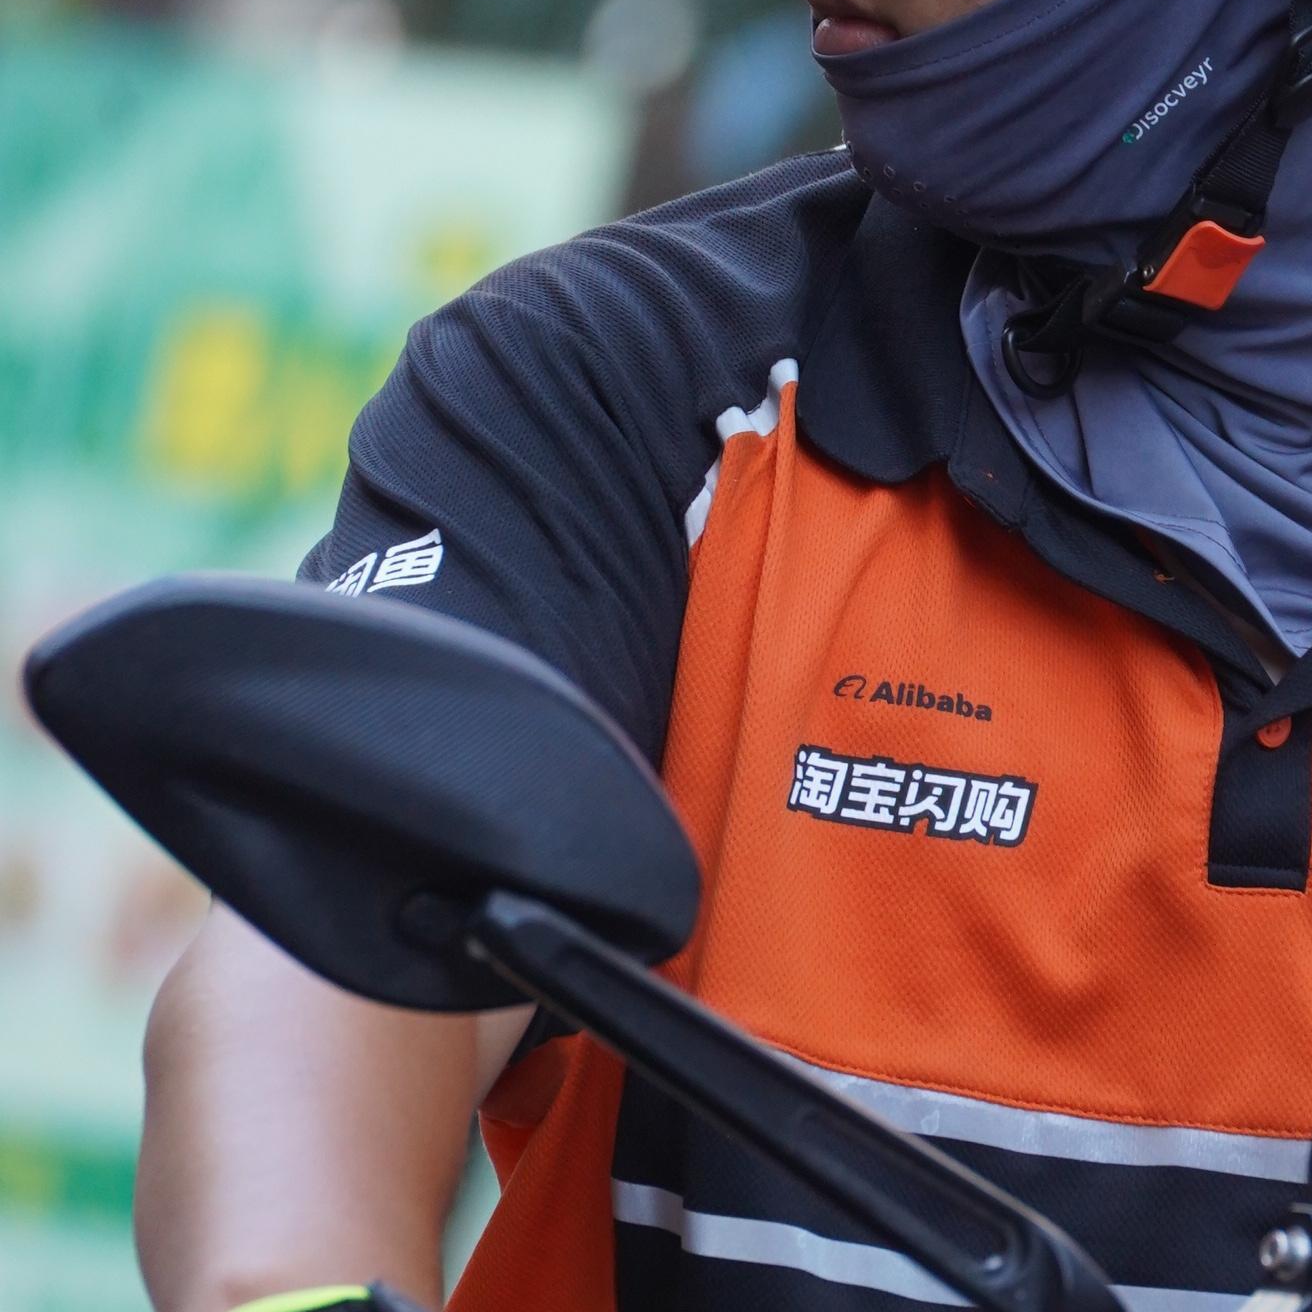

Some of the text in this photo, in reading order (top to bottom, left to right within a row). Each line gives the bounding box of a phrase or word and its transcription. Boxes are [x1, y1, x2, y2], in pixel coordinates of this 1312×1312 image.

[869, 681, 993, 721] Alibaba
[789, 748, 1032, 842] 淘宝闪购
